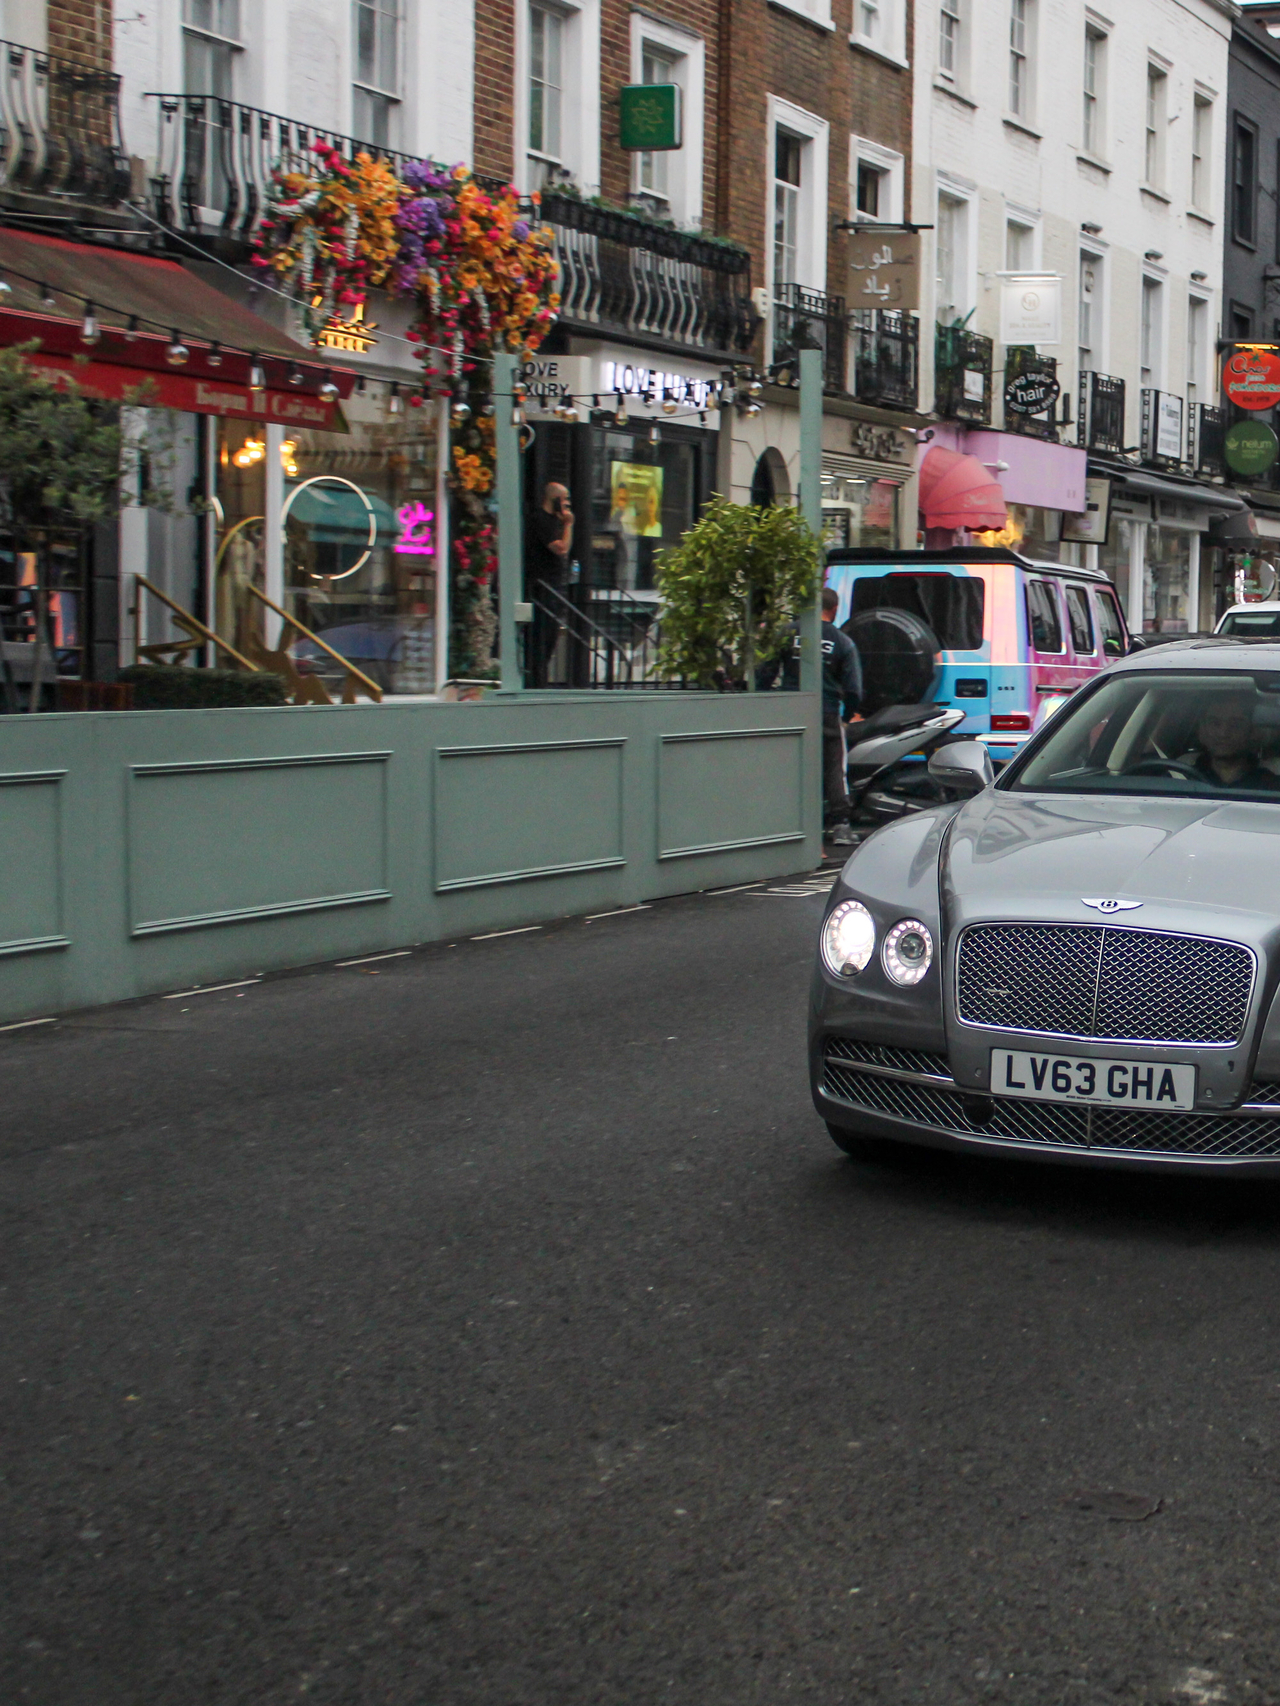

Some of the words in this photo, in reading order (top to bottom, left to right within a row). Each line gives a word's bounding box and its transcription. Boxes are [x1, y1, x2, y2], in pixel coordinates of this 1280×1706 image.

[524, 361, 558, 377] OVE
[526, 382, 570, 397] XURY
[1016, 384, 1046, 403] hair
[1006, 1054, 1096, 1096] LV63
[1107, 1064, 1177, 1102] GHA
